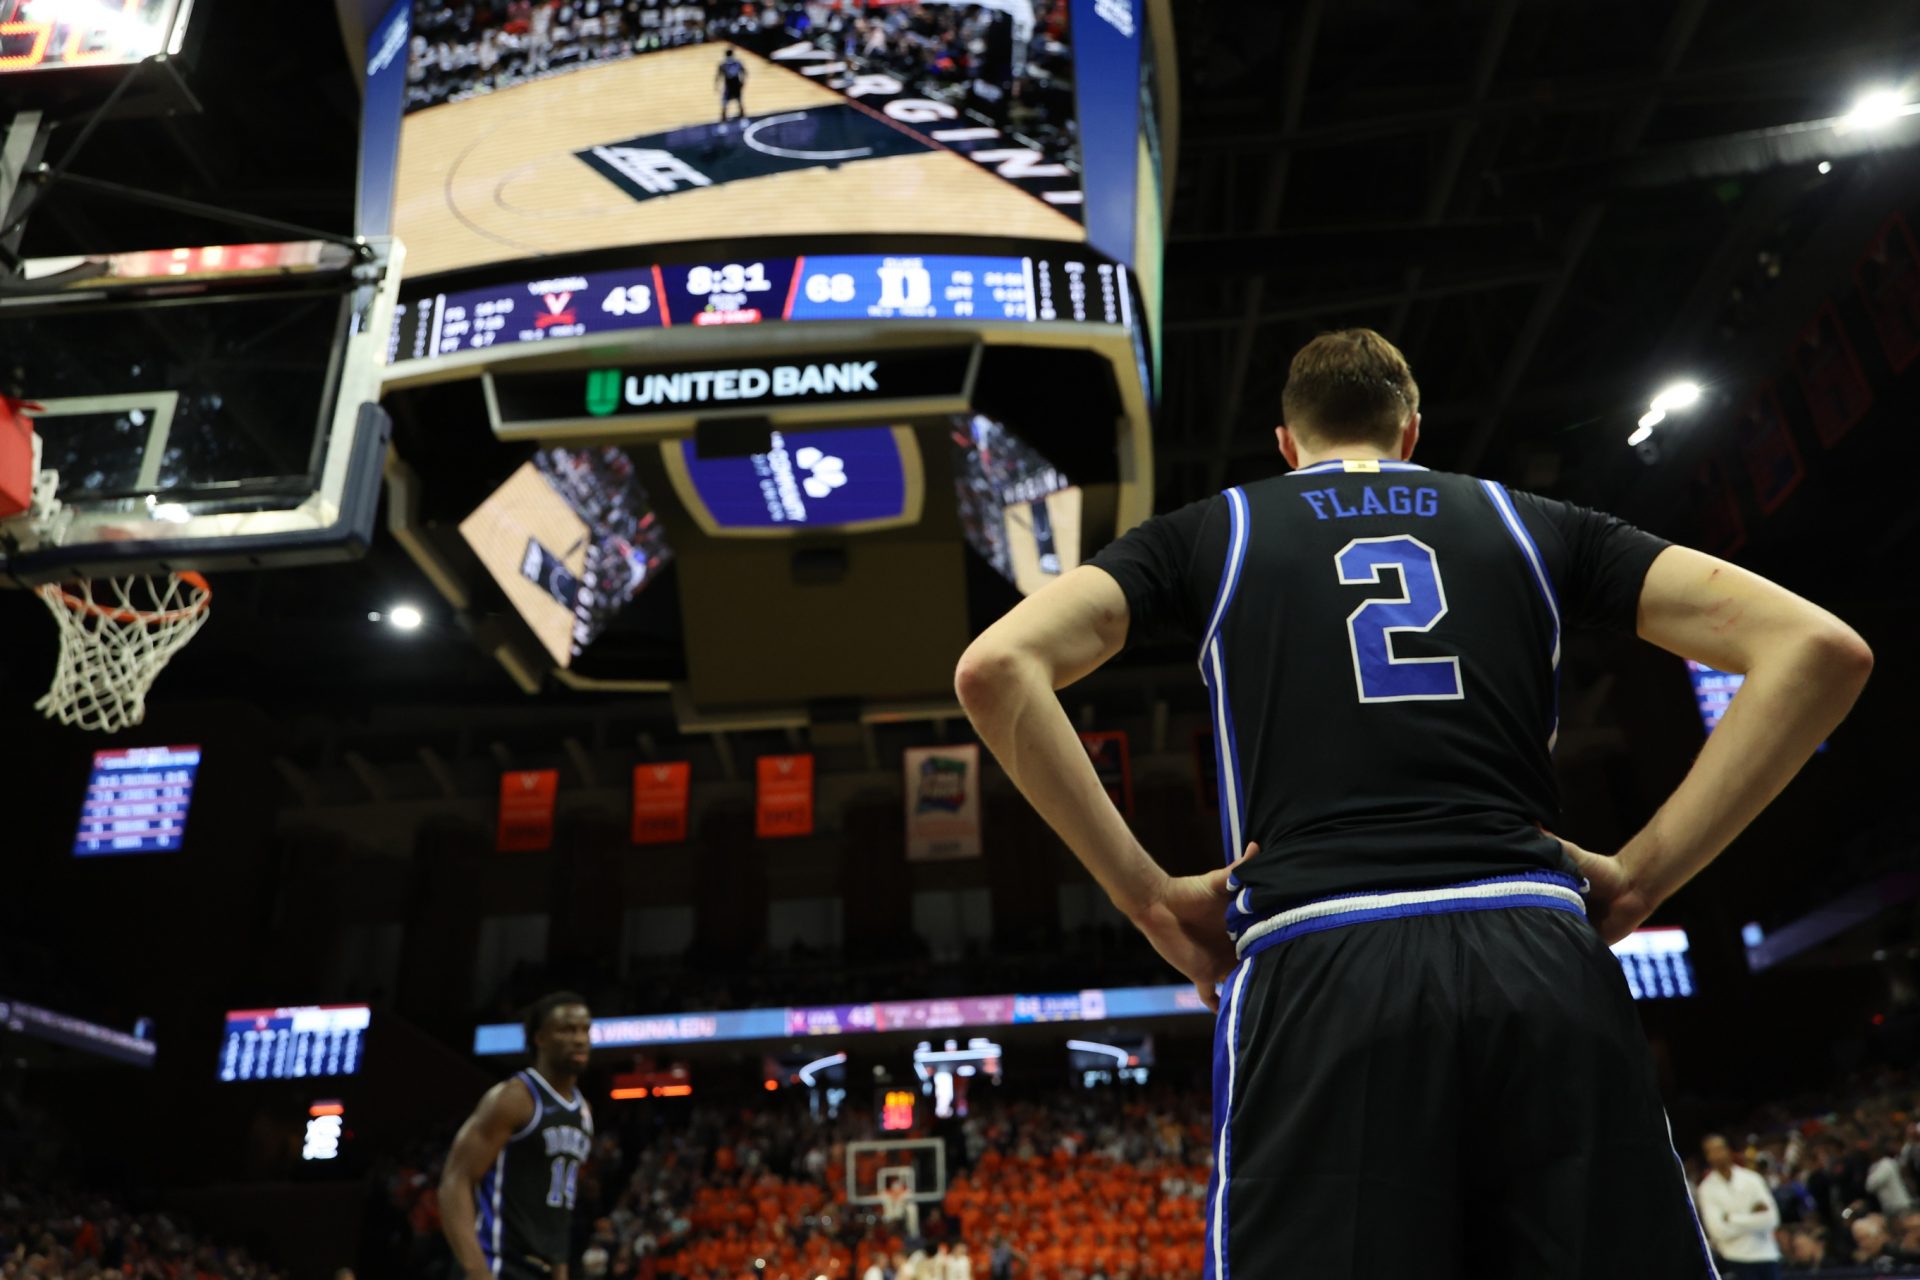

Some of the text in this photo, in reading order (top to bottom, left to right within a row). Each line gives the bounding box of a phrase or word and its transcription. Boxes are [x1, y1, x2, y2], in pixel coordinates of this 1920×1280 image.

[686, 262, 772, 295] 8:31
[601, 284, 651, 316] 43
[625, 368, 770, 406] UNITED
[771, 360, 879, 396] BANK
[1301, 486, 1439, 520] FLAGG
[1333, 534, 1465, 703] 2
[542, 1125, 591, 1166] DUKE
